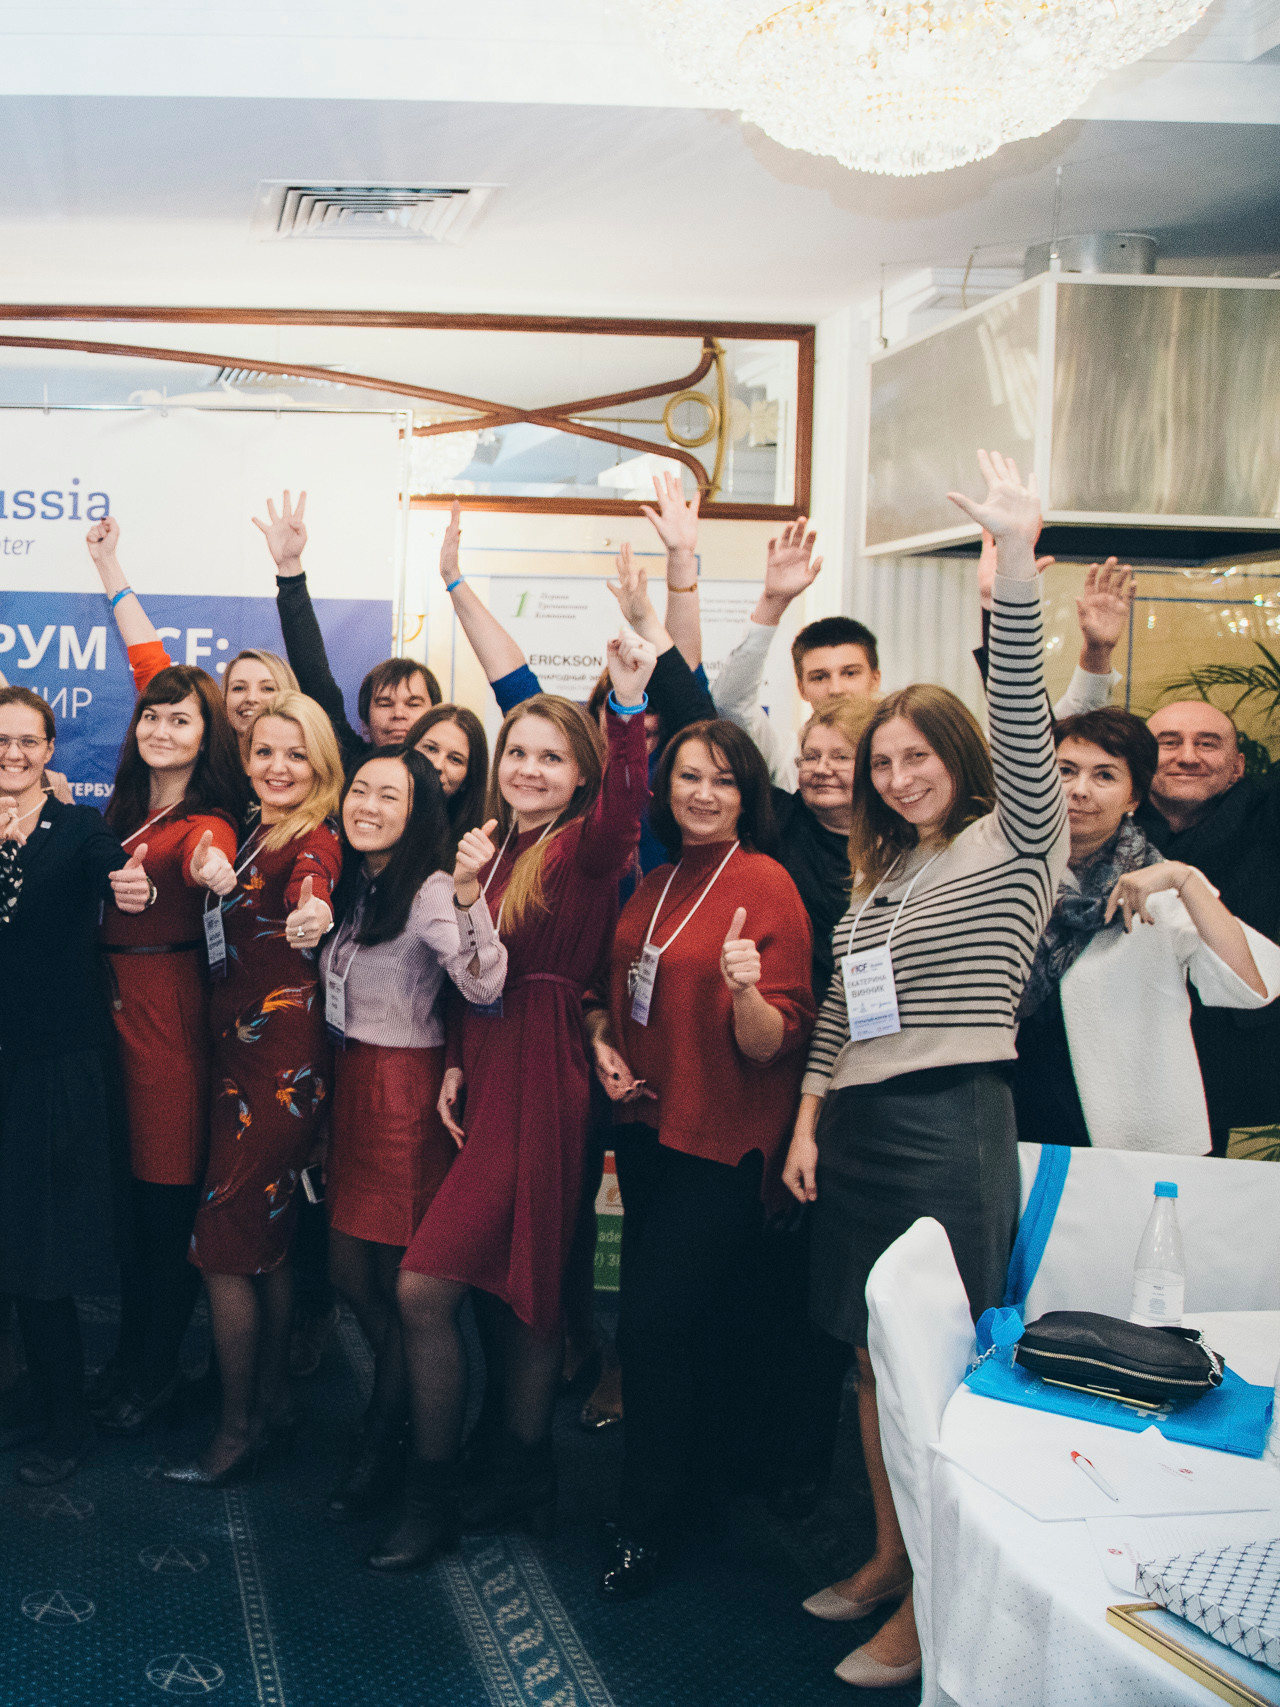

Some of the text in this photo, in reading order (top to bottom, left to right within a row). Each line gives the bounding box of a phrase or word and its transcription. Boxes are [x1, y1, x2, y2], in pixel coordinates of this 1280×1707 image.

[529, 654, 602, 667] ERICKSON
[31, 686, 93, 719] ИР
[67, 782, 115, 797] ТЕРБУ
